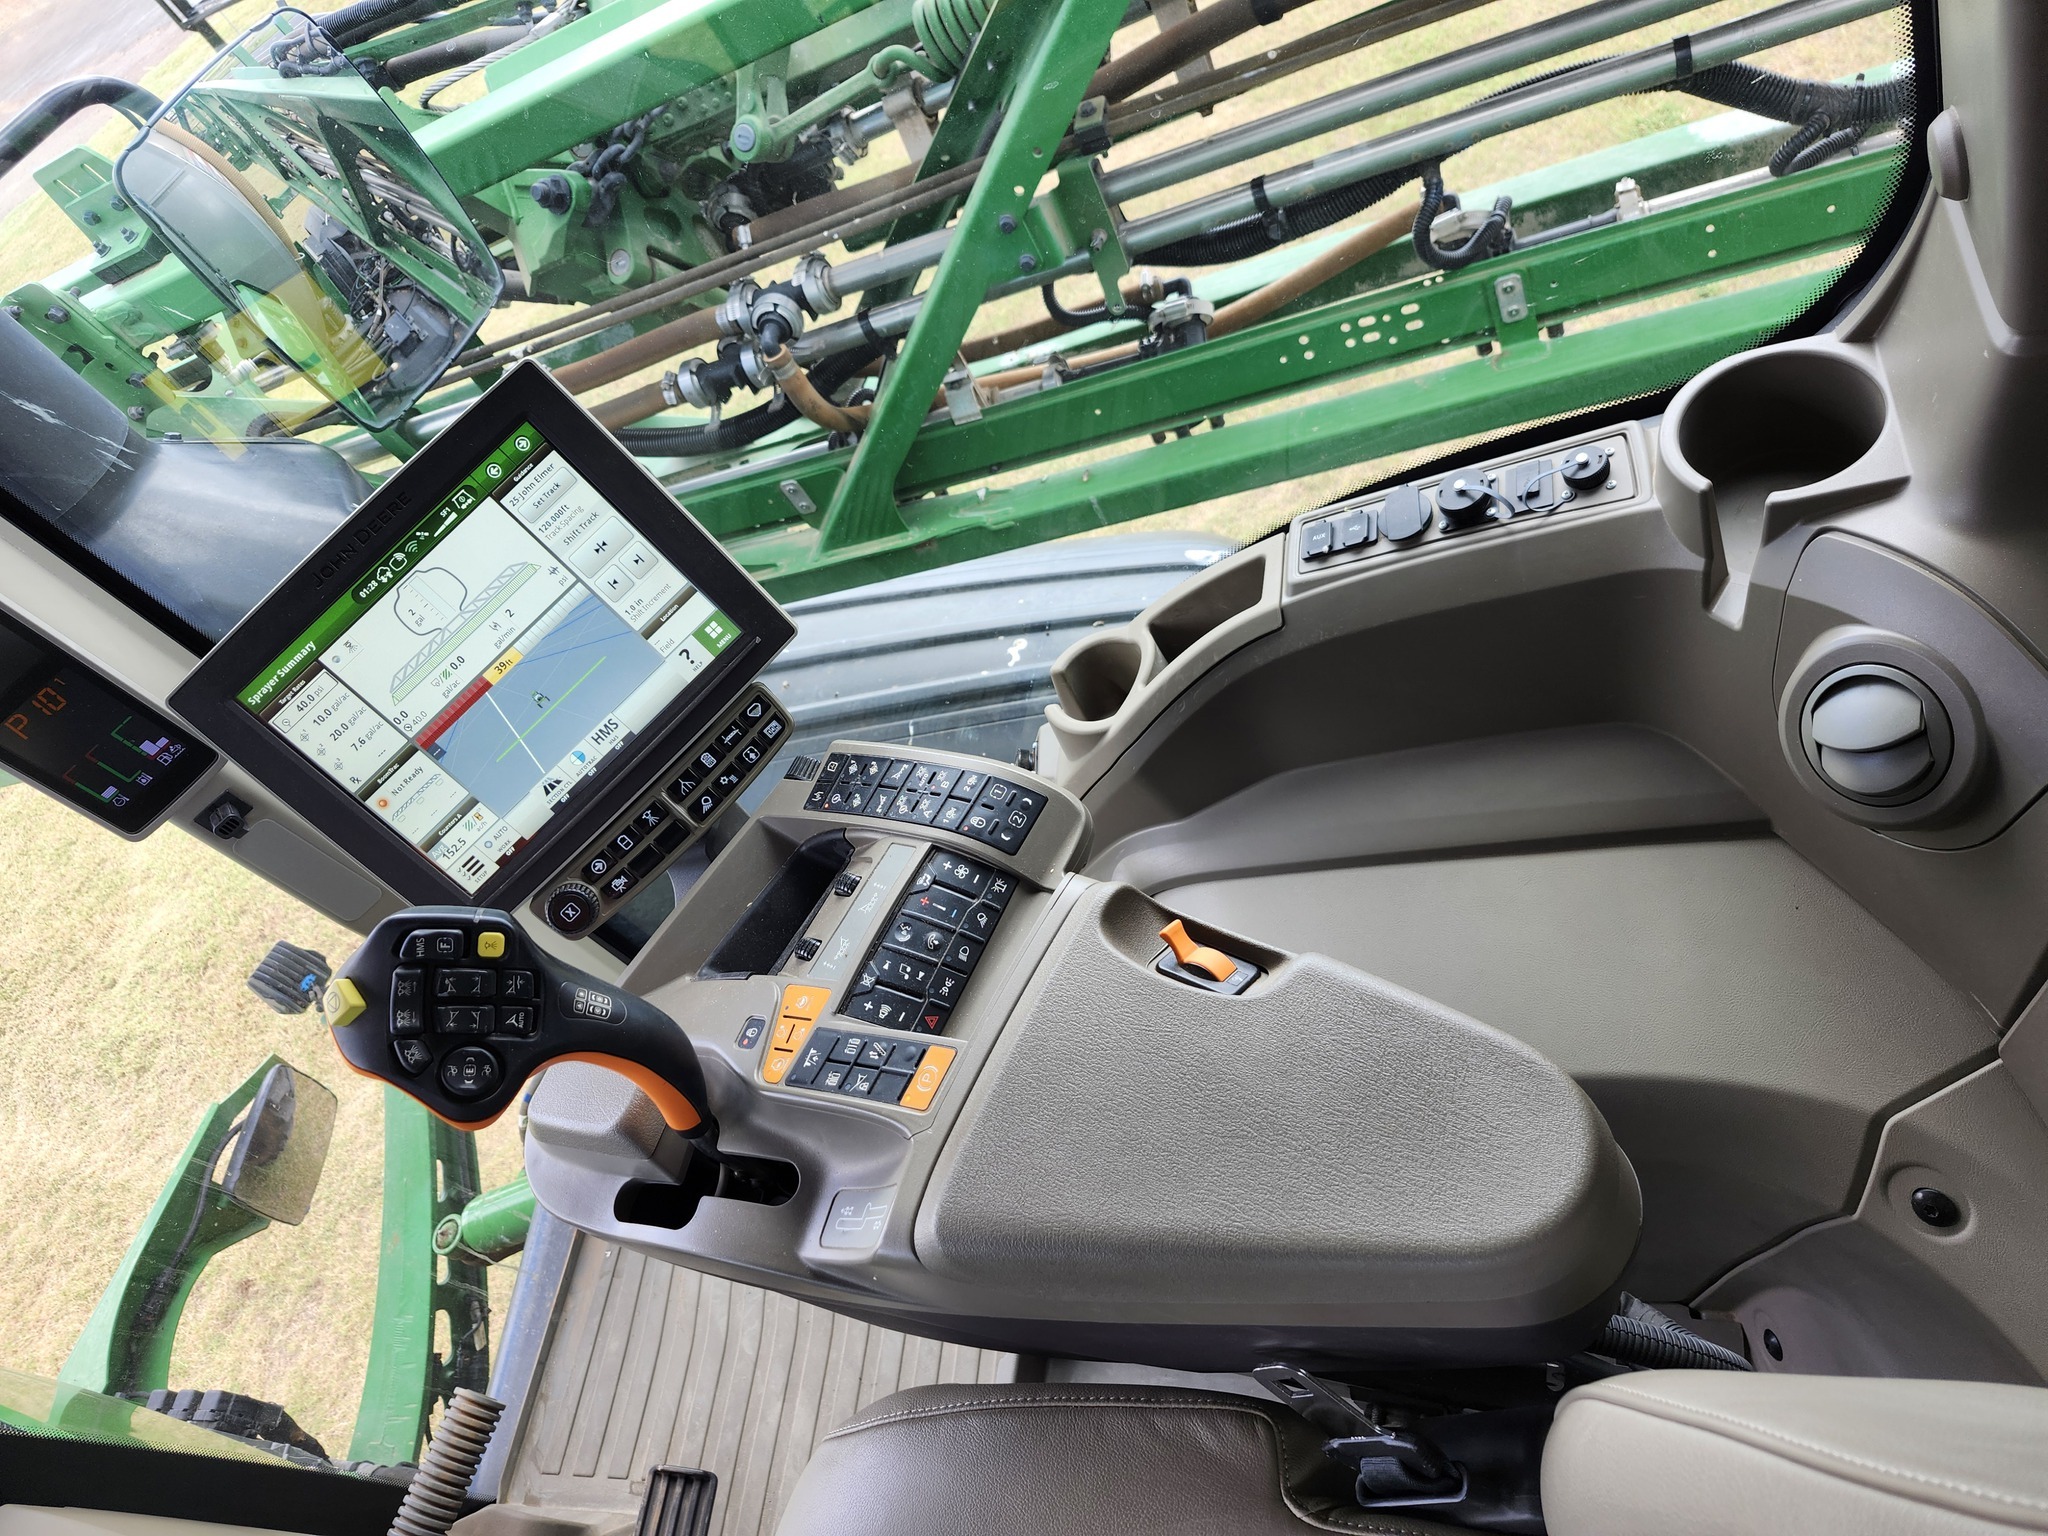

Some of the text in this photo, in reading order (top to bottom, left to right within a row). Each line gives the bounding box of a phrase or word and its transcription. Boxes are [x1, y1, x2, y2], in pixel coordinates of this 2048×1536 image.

[512, 461, 534, 482] Guidance
[533, 461, 555, 483] Elmer
[532, 481, 561, 509] Set Track
[439, 506, 451, 517] SF1
[537, 502, 570, 534] 120.000ft
[544, 504, 585, 541] Track Spacing
[562, 510, 599, 546] Shift Track
[306, 489, 413, 589] JOHN DEERE
[1313, 532, 1326, 541] AUX
[358, 579, 379, 598] 01:28
[556, 574, 569, 586] psi
[407, 608, 416, 616] 2
[504, 608, 514, 617] 2
[624, 596, 643, 616] 1.0 in
[629, 582, 671, 622] Shift Increment
[659, 602, 679, 622] Location
[412, 614, 427, 627] gal
[491, 624, 517, 649] gal/min
[659, 637, 675, 653] Field
[716, 632, 732, 648] MENU
[246, 639, 318, 707] Sprayer Summary
[449, 655, 465, 670] 0.0
[294, 684, 325, 713] 40.0 psi
[439, 677, 462, 699] gal/ac
[312, 690, 351, 726] 10.0 gal/ac
[392, 709, 409, 725] 0.0
[410, 709, 428, 726] 40.0
[3, 713, 31, 741] P
[328, 704, 368, 741] 20.0 gal/ac
[590, 717, 619, 745] HMS
[350, 719, 385, 751] 7.6 gal/ac
[390, 765, 425, 796] Not Ready
[437, 816, 458, 836] Counters
[492, 825, 508, 840] AUTO
[430, 842, 448, 860] Avg
[441, 836, 467, 861] 152.5
[416, 937, 425, 957] HMS
